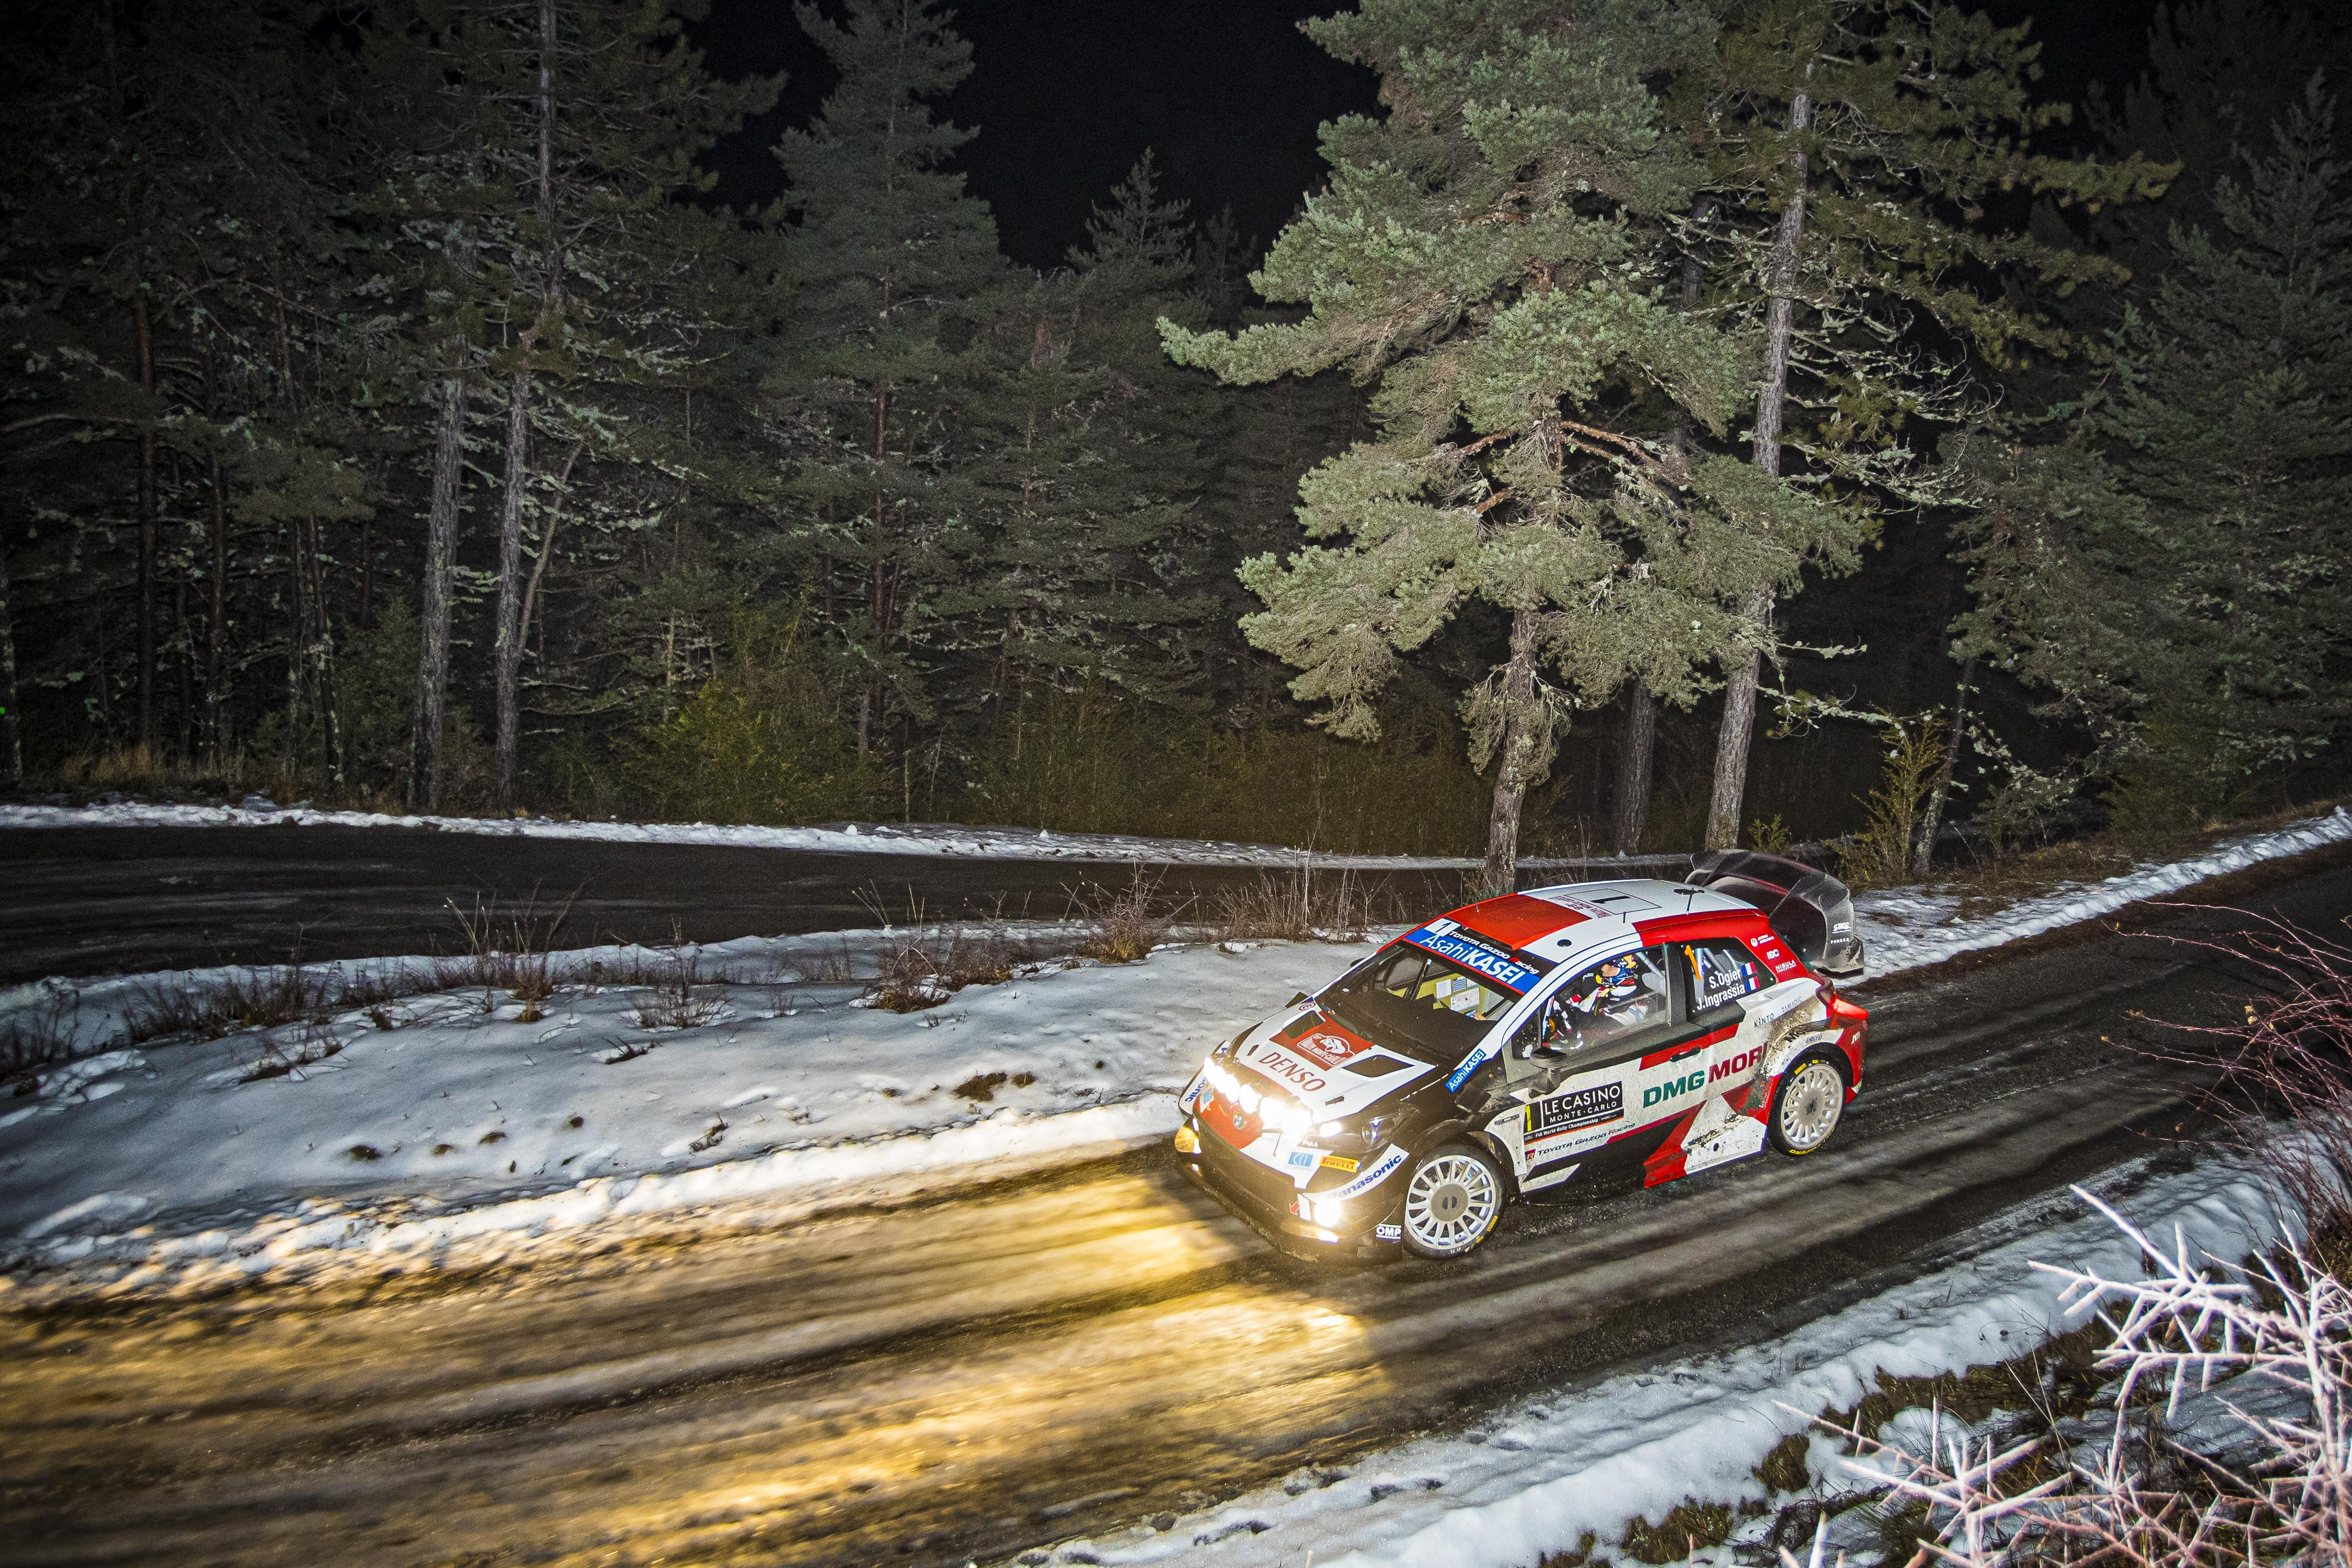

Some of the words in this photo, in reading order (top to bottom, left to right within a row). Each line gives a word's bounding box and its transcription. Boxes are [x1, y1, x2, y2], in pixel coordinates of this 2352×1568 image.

[1435, 921, 1451, 933] 1
[1449, 931, 1478, 946] TOYOTA
[1479, 943, 1511, 959] GAZOO
[1509, 956, 1540, 974] Racing
[1684, 944, 1702, 980] 1
[1709, 968, 1741, 989] S.Ogier
[1697, 983, 1746, 1011] J.Ingrassia
[1781, 996, 1803, 1013] TAMADIC
[1259, 1052, 1326, 1091] DENSO
[1643, 1070, 1705, 1108] DMG
[1708, 1041, 1768, 1083] MORI
[1544, 1100, 1560, 1115] LE
[1562, 1085, 1620, 1110] CASINO
[1525, 1105, 1532, 1132] 1
[1568, 1118, 1598, 1129] Championship
[1538, 1142, 1573, 1156] TOYOTA
[1575, 1132, 1607, 1145] GAZOO
[1608, 1123, 1635, 1136] Racing
[1322, 1157, 1355, 1169] PIRELLI
[1376, 1227, 1402, 1237] OMP
